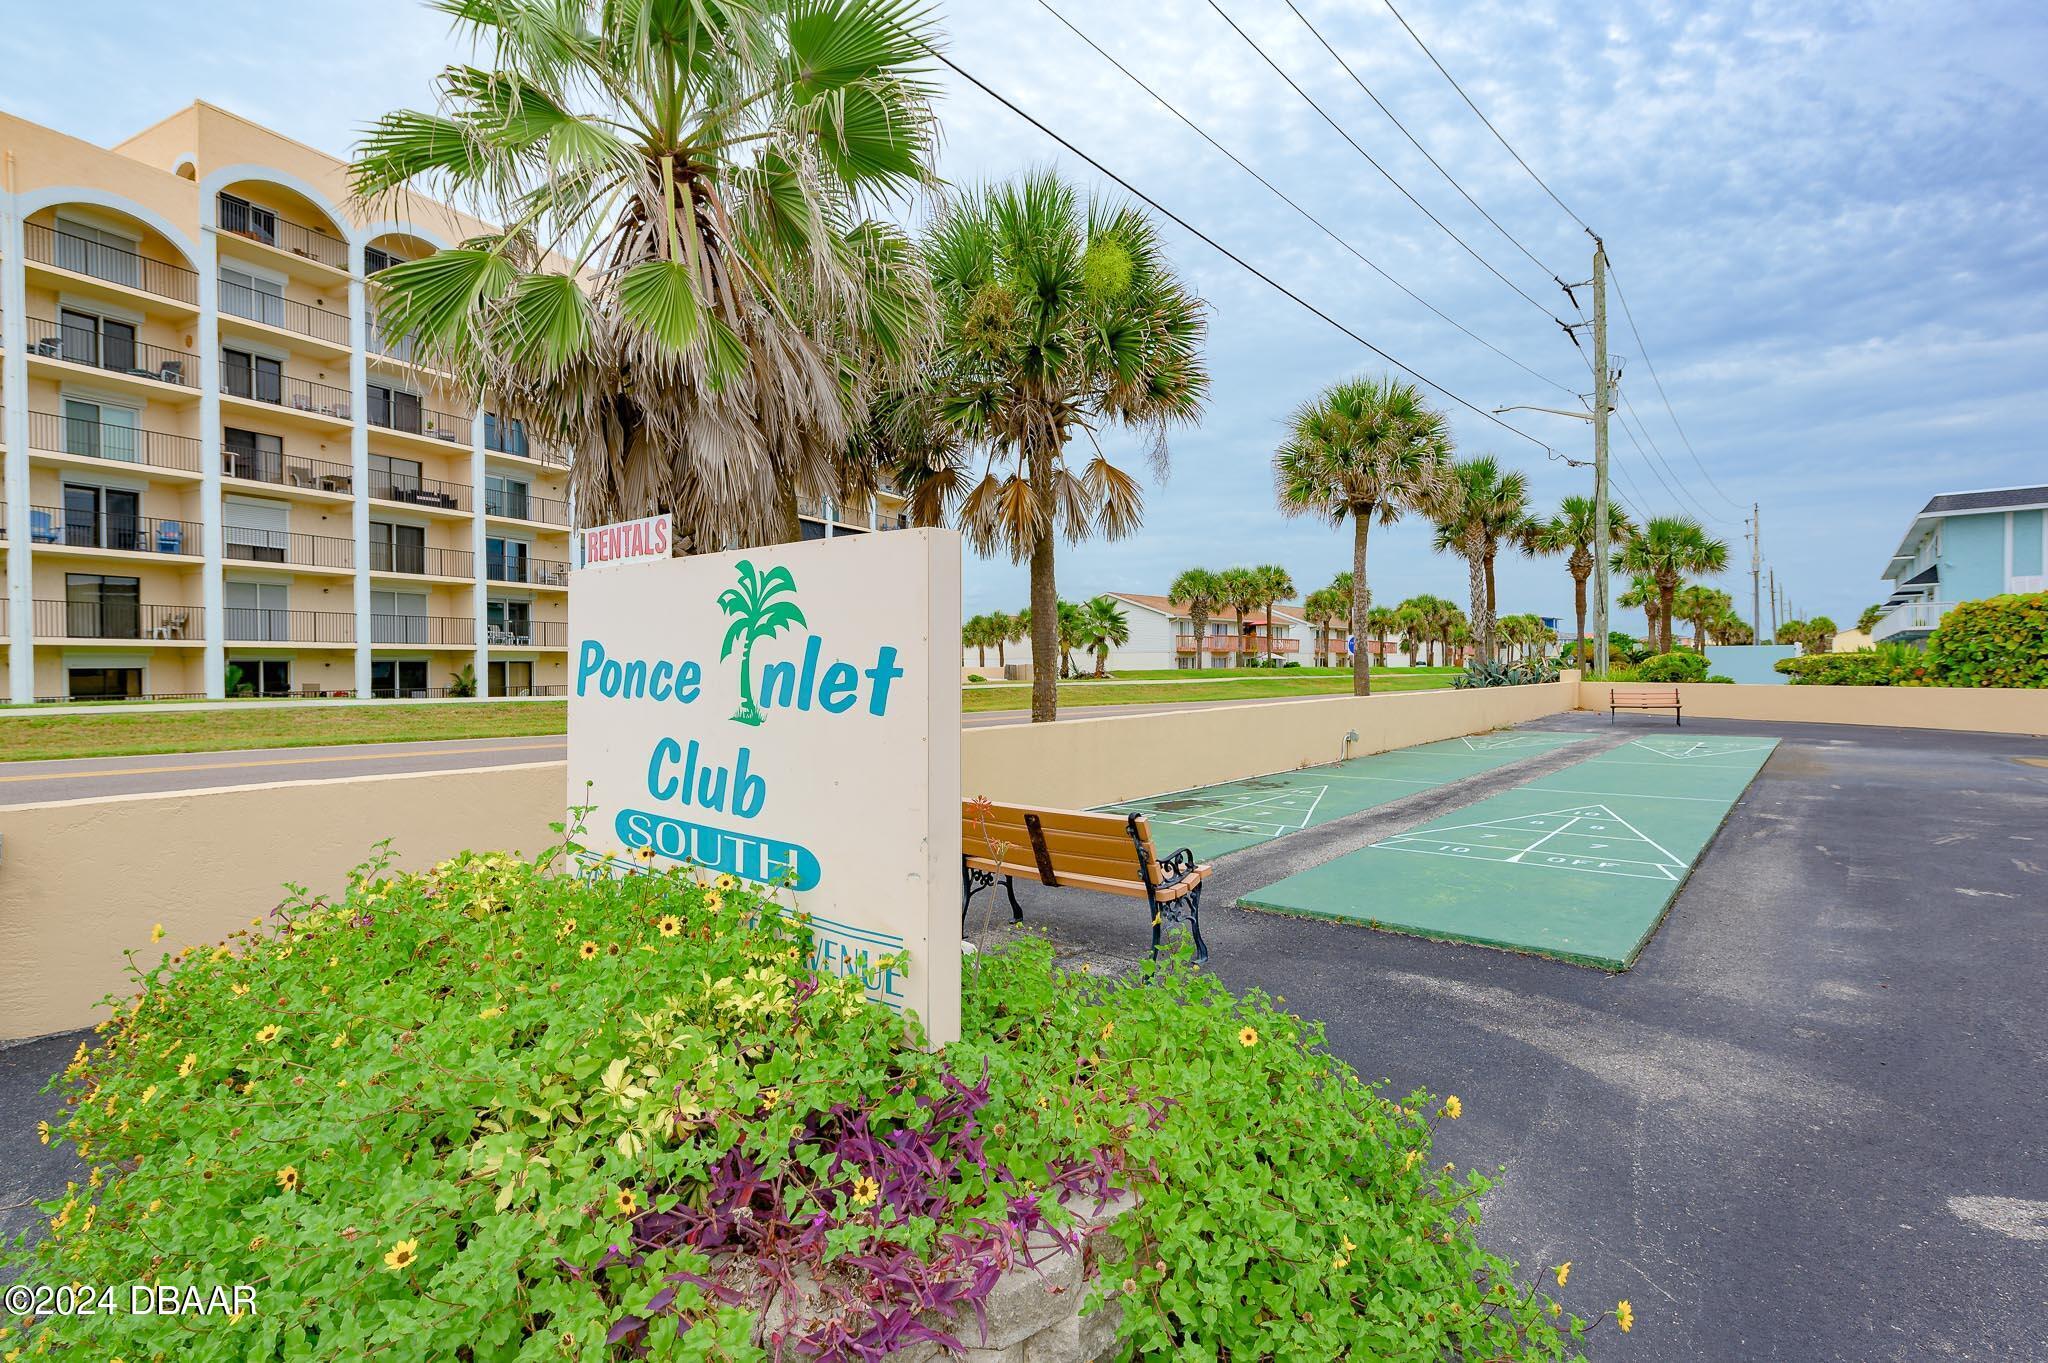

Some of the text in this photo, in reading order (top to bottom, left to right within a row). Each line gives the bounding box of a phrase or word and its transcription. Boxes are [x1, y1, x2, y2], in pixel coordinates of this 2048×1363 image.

[588, 518, 667, 563] RENTALS
[577, 639, 701, 704] Ponce
[647, 737, 767, 819] Club
[628, 815, 798, 887] SOUTH
[1546, 856, 1621, 868] OFF
[802, 933, 904, 998] VENUE
